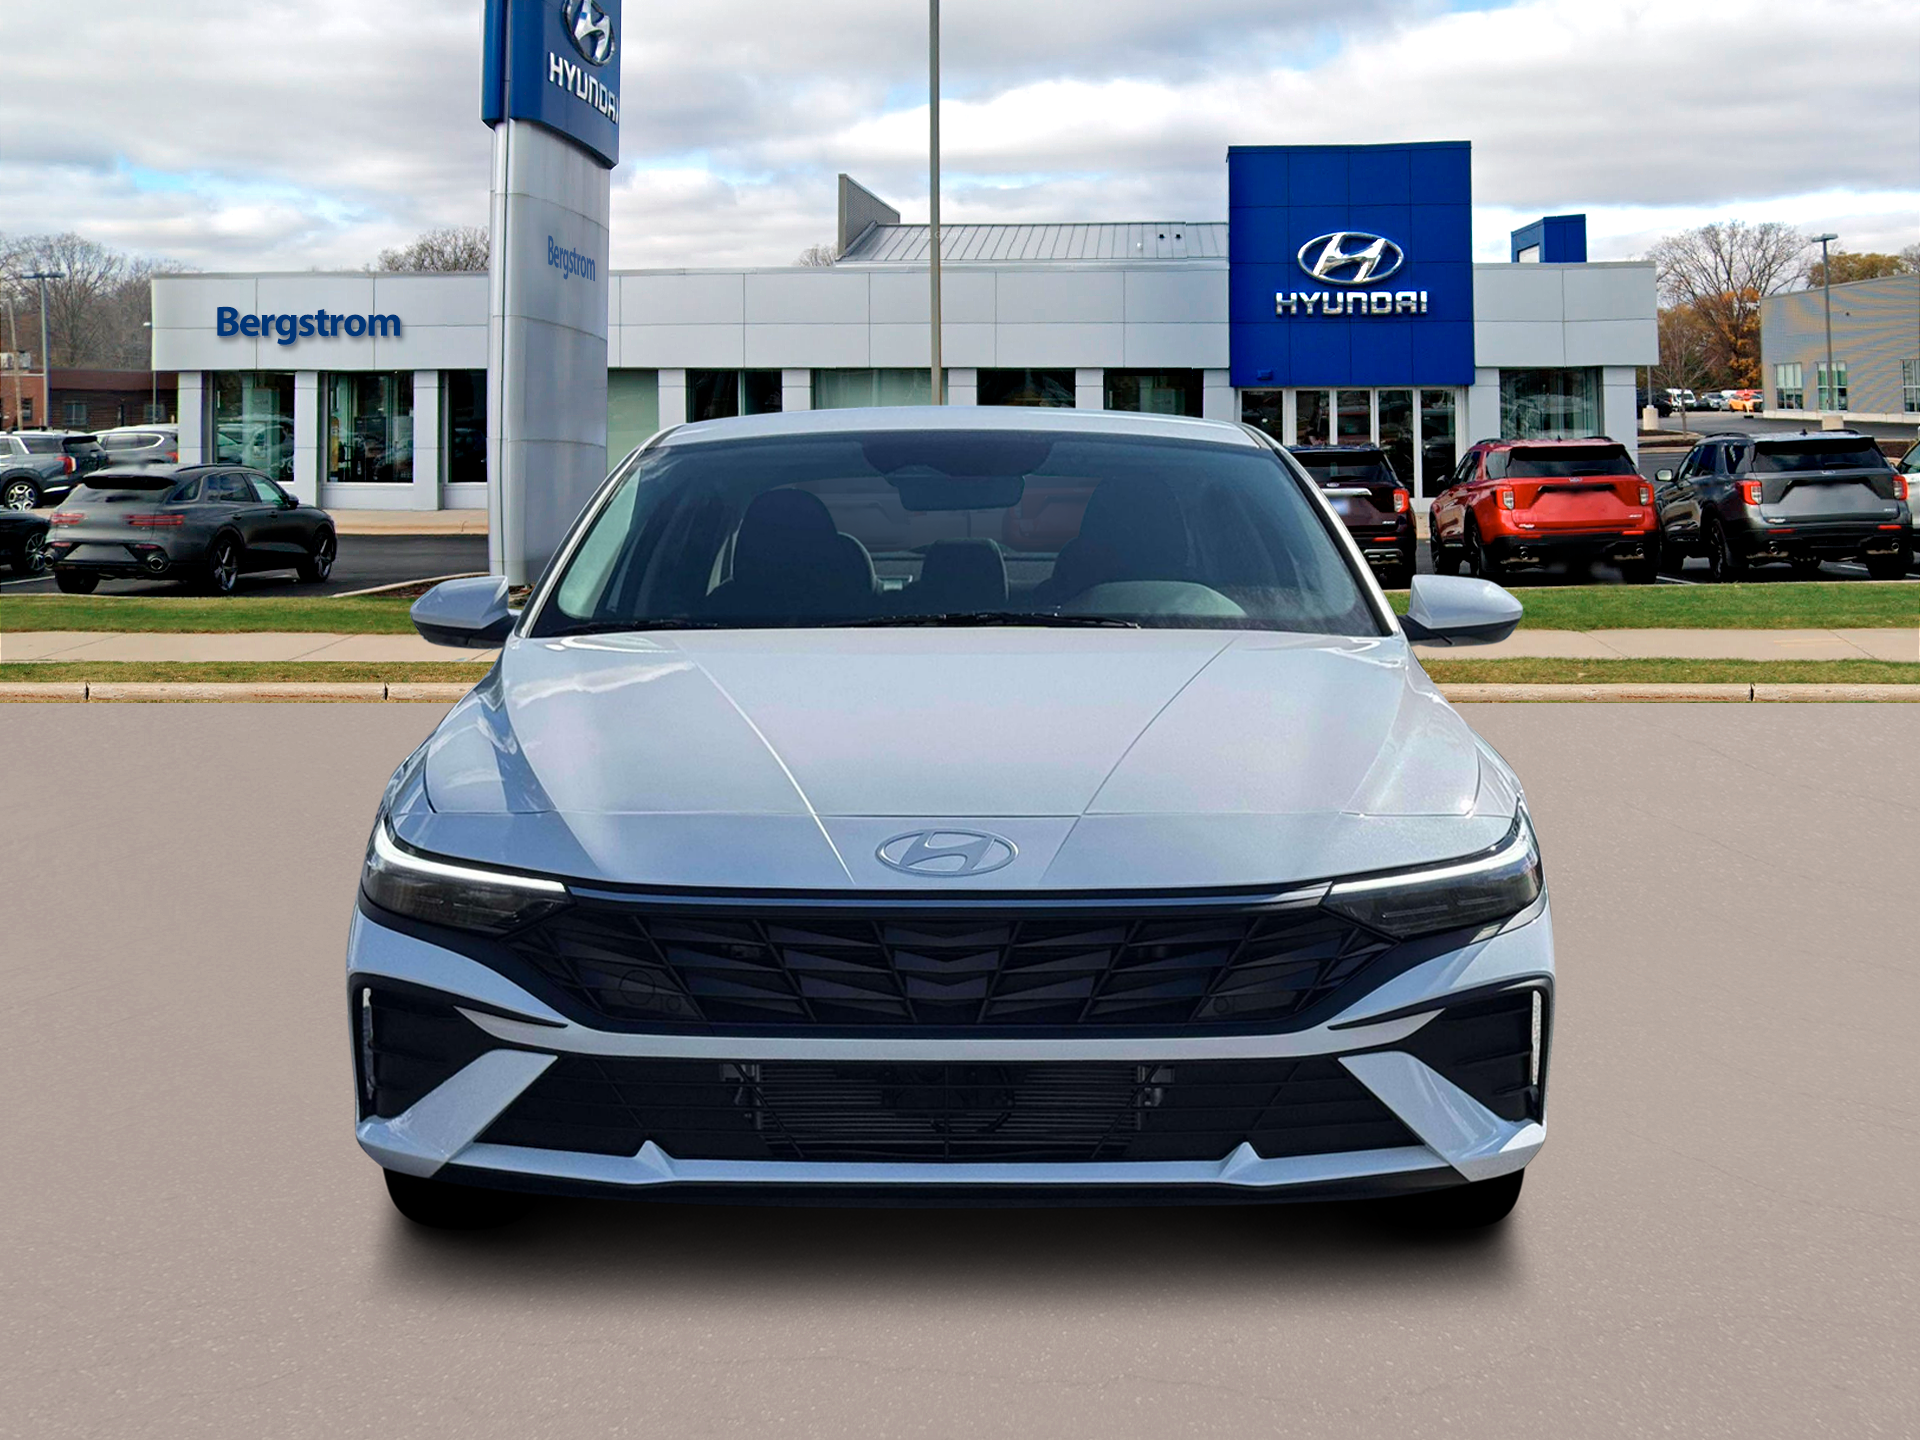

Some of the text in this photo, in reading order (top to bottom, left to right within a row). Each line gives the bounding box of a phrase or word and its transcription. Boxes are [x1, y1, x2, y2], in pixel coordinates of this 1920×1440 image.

[548, 51, 619, 124] HYUNDAI
[547, 235, 596, 282] Bergstrom
[1275, 290, 1428, 316] HYUNDAI
[216, 306, 401, 346] Bergstrom
